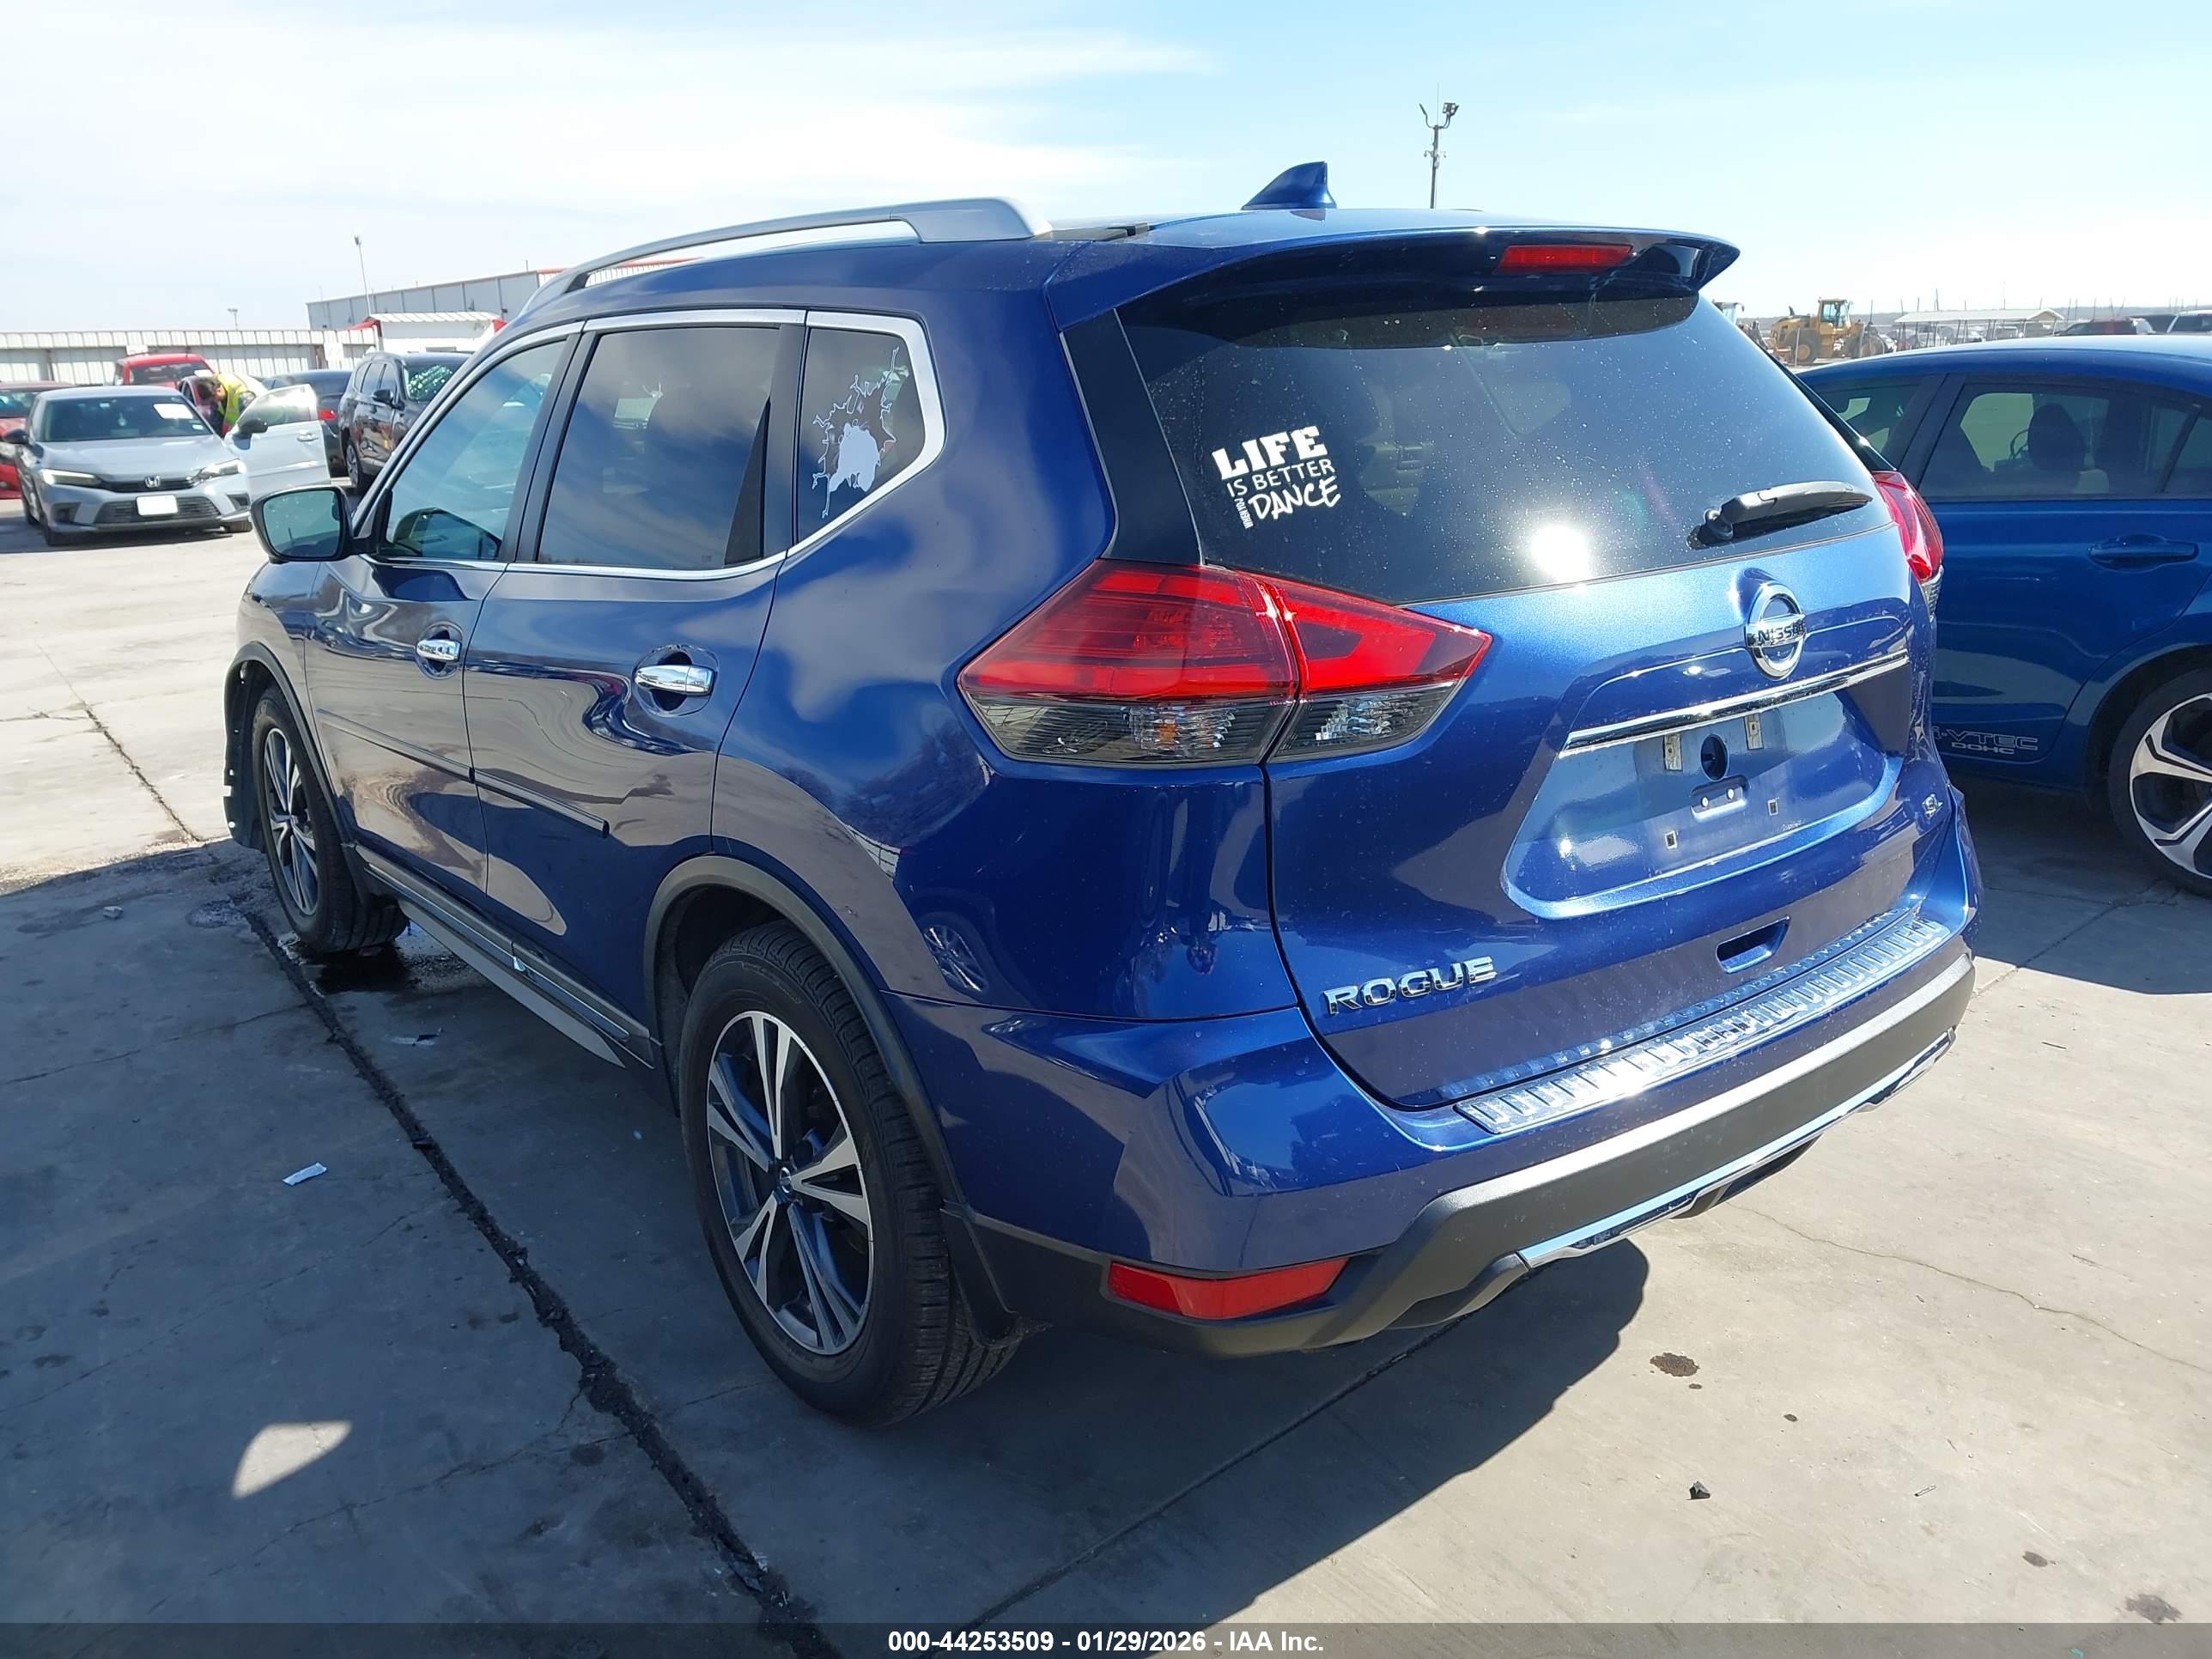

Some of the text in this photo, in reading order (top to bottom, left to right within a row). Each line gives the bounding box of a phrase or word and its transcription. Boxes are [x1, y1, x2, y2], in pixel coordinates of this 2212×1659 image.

[1212, 425, 1328, 480] LIFE
[1226, 459, 1336, 497] IS BETTER
[1248, 475, 1341, 520] DANCE
[1951, 741, 2015, 755] DOHC
[1322, 956, 1498, 1016] ROGUE
